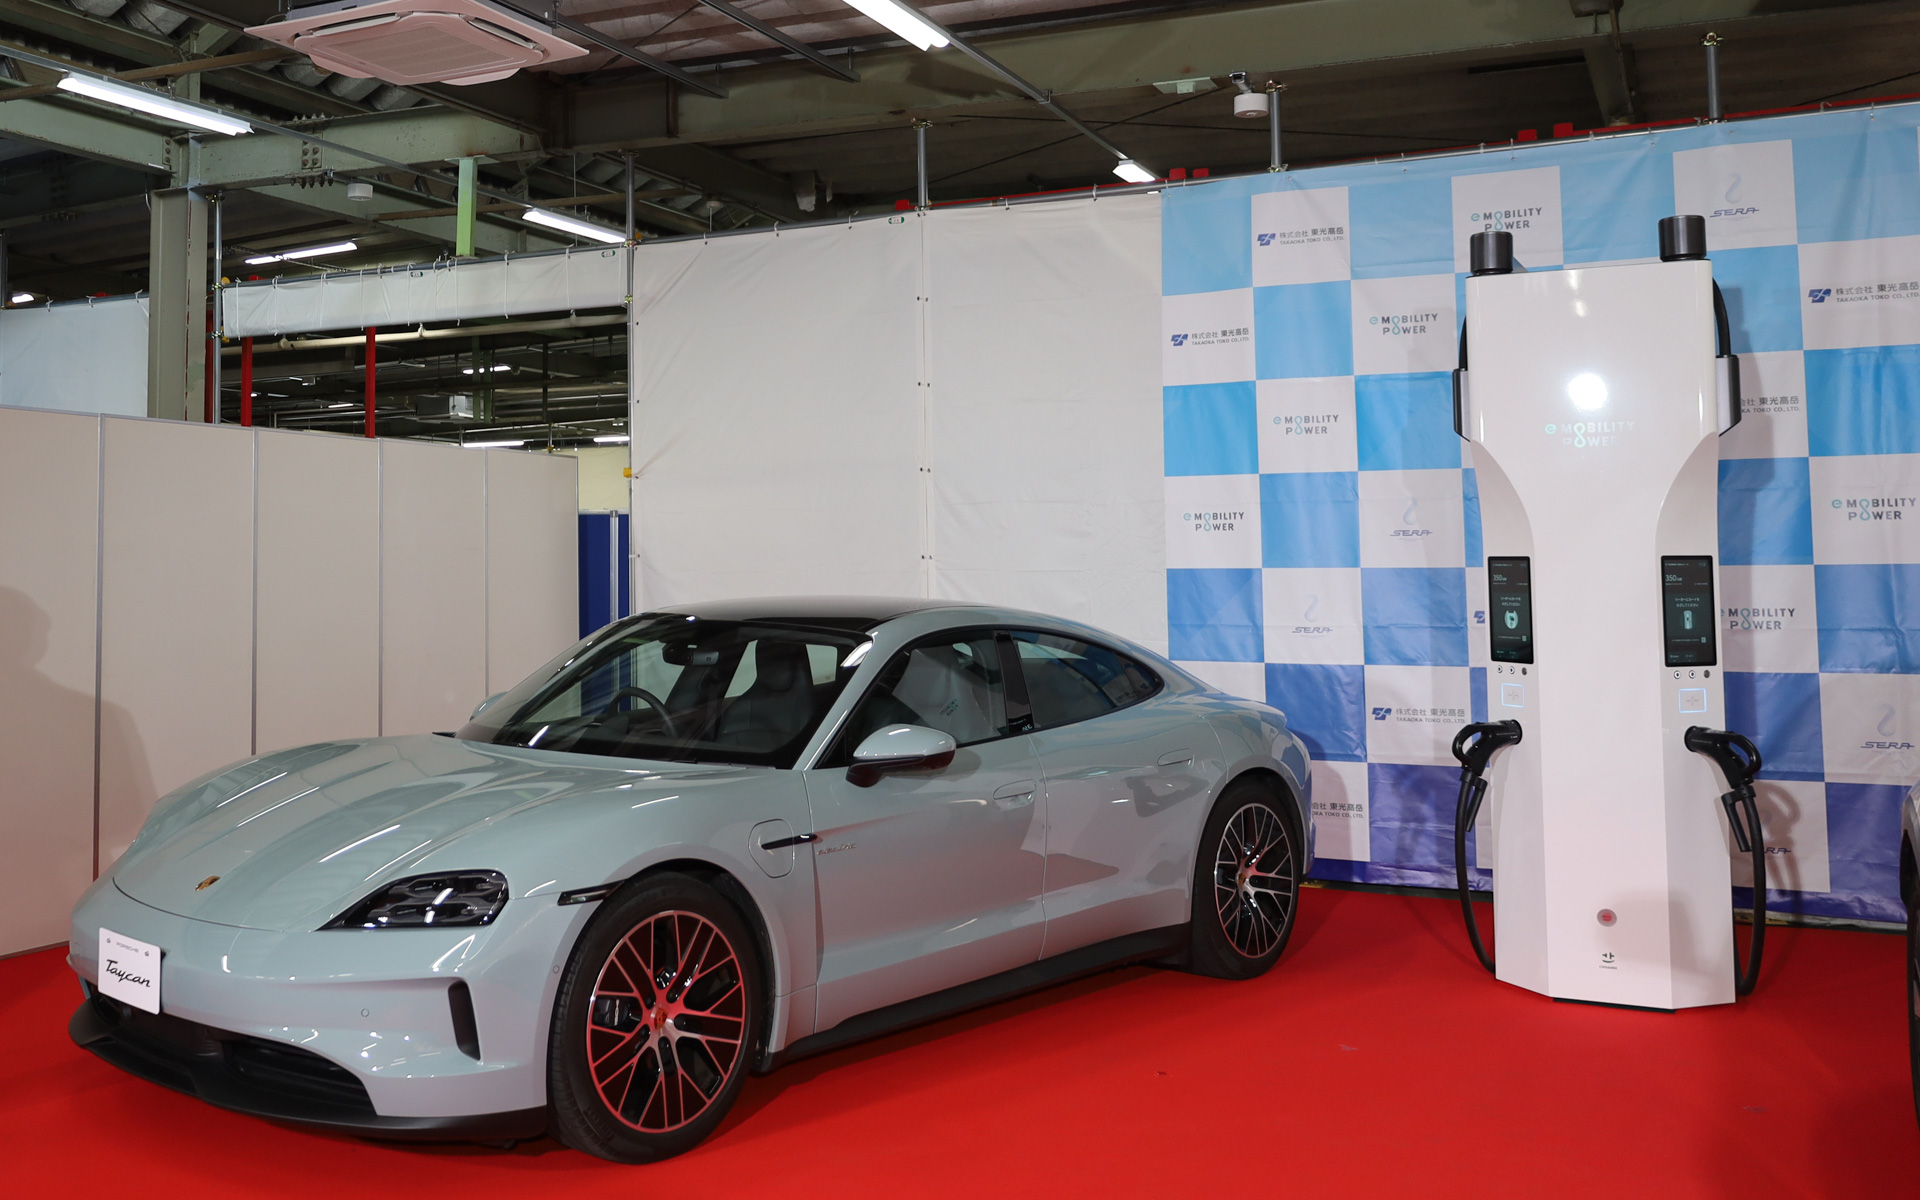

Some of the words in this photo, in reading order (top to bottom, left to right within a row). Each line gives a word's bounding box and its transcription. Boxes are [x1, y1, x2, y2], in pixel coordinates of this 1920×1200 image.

[1484, 207, 1542, 220] MOBILITY
[1710, 207, 1759, 218] SERA
[1485, 220, 1530, 231] POWER
[1280, 230, 1308, 238] 株式会社
[1836, 286, 1873, 296] 株式会社
[1382, 313, 1438, 324] MOBILITY
[1383, 325, 1426, 335] POWER
[1285, 414, 1339, 424] MOBILITY
[1286, 426, 1327, 435] POWER
[1561, 421, 1635, 434] MOBILITY
[1562, 436, 1618, 448] POWER
[1846, 498, 1916, 508] MOBILITY
[1194, 512, 1244, 520] MOBILITY
[1848, 511, 1902, 521] POWER
[1195, 523, 1234, 531] POWER
[1728, 608, 1795, 617] MOBILITY
[1730, 621, 1782, 630] POWER
[106, 959, 150, 987] Taycan
